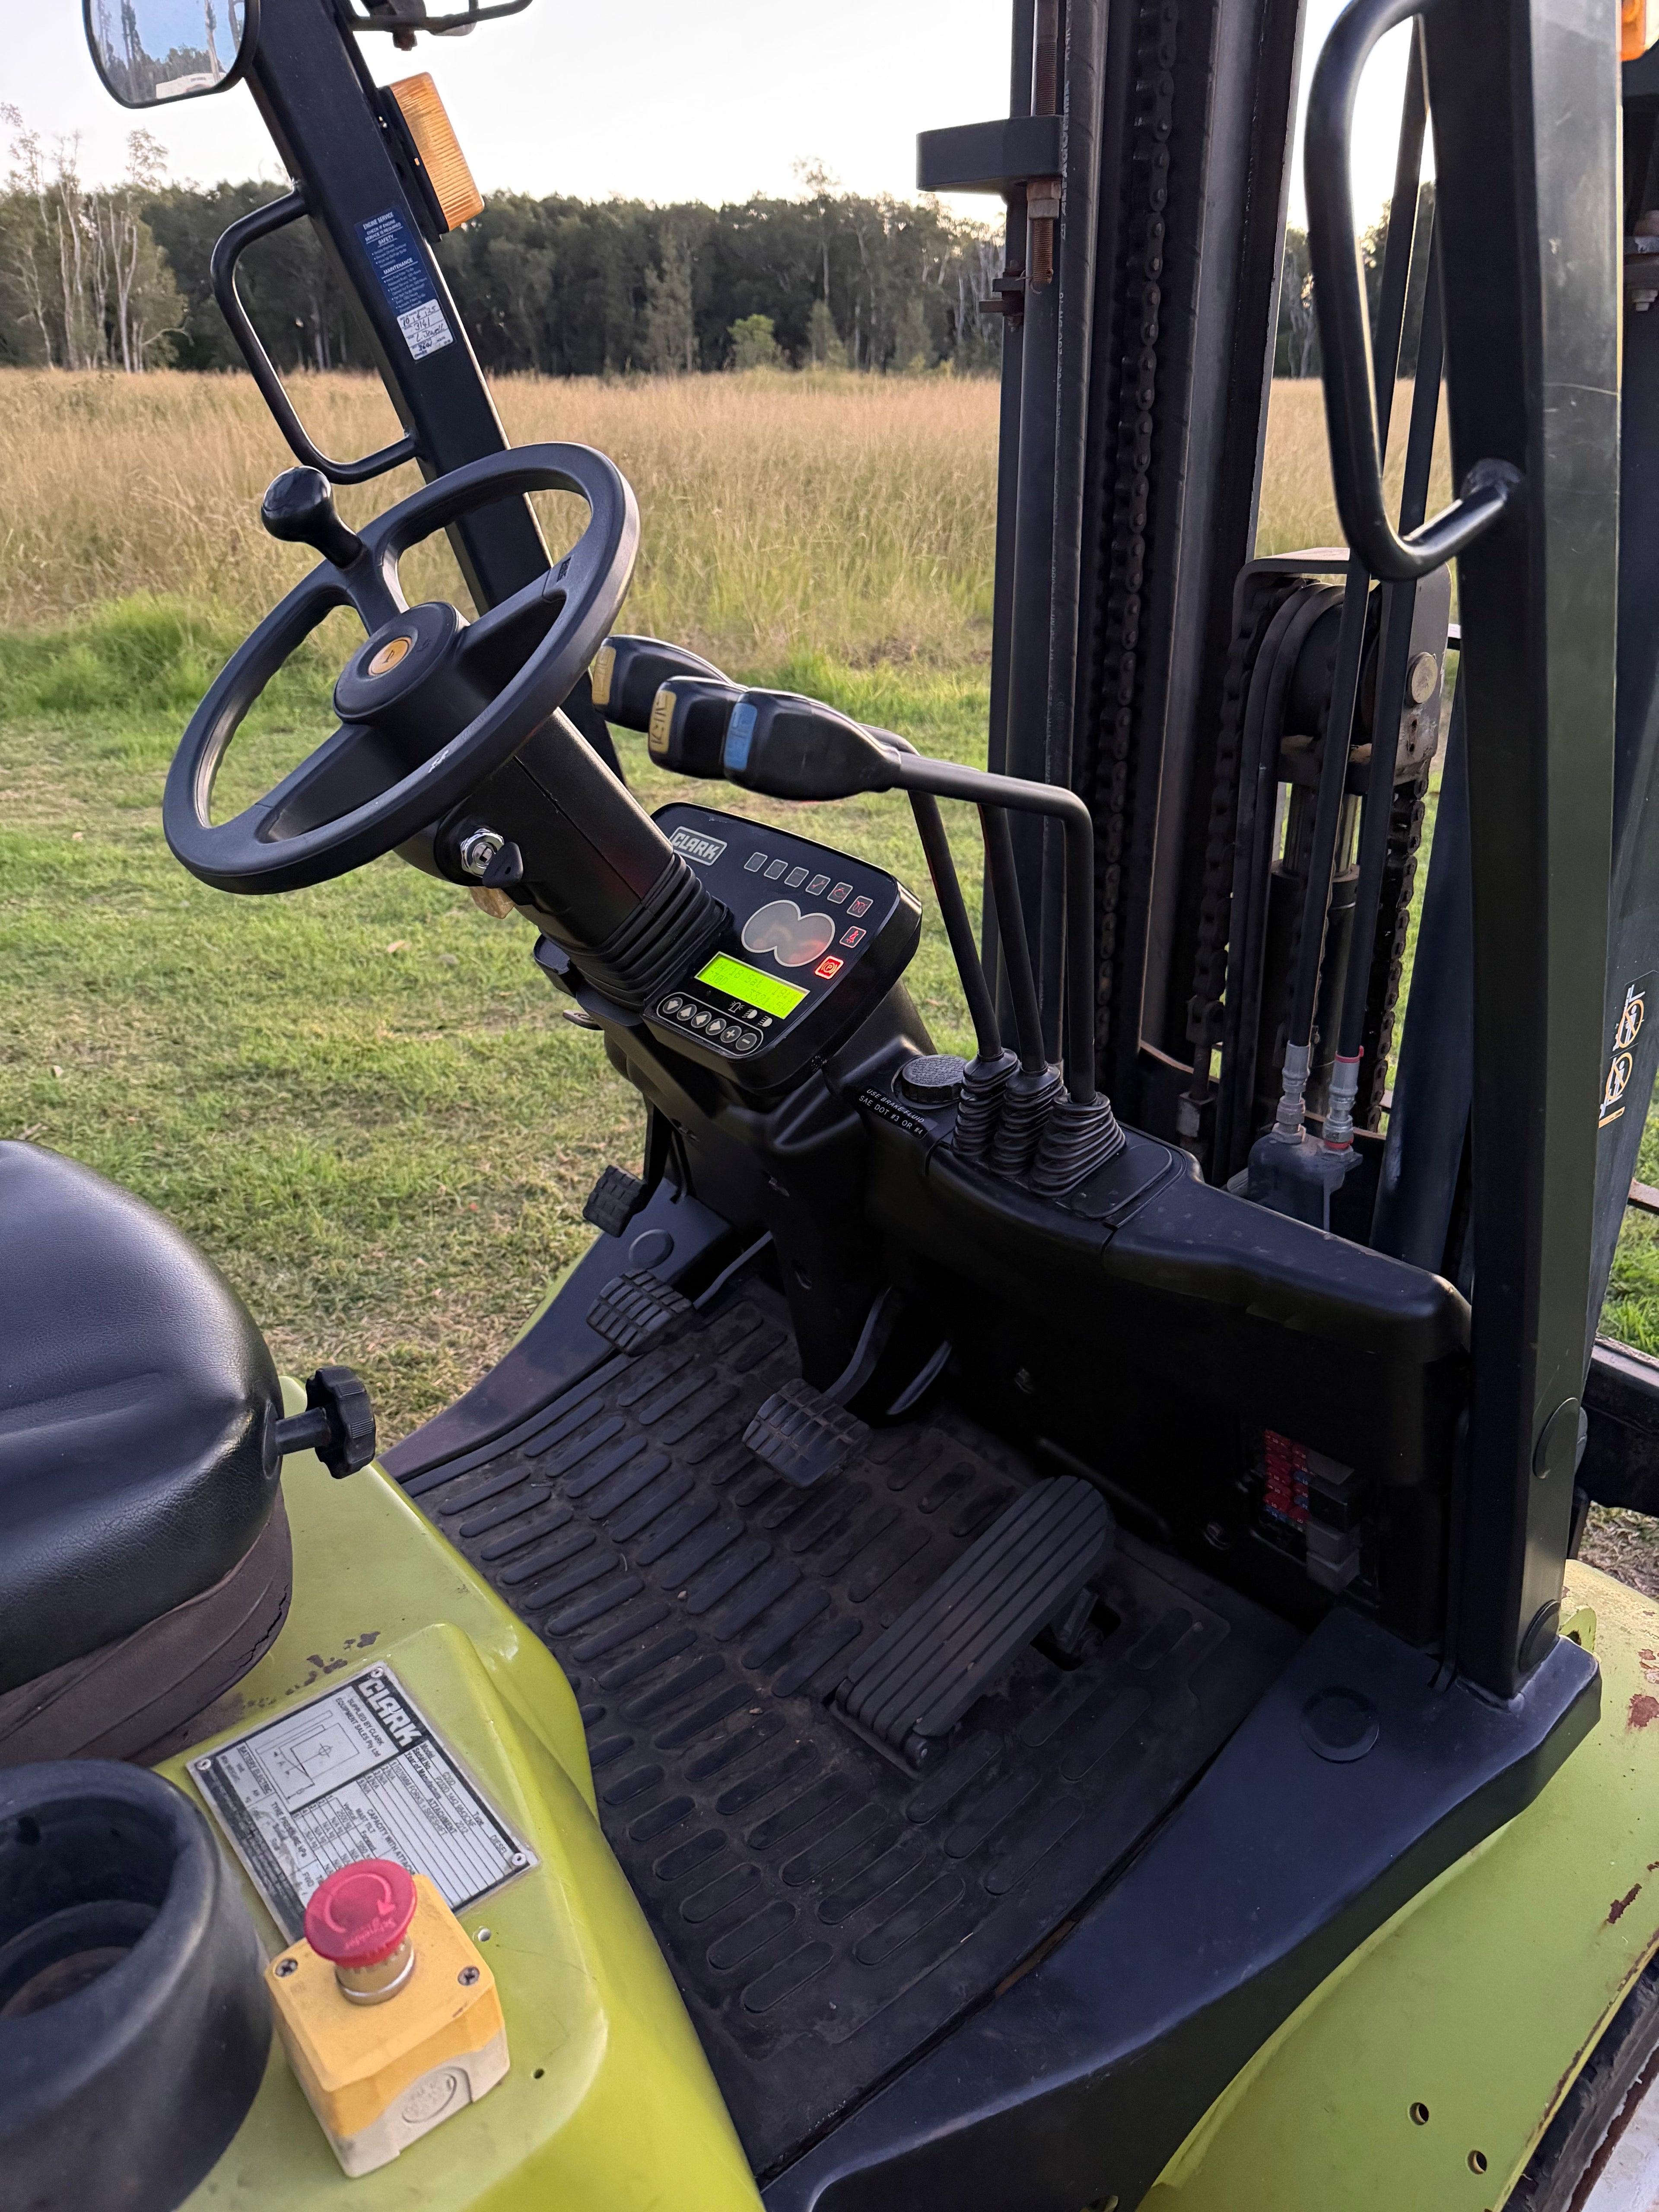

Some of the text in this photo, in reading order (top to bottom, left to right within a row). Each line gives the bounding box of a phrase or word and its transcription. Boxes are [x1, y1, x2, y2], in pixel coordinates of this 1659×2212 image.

[377, 211, 394, 223] SERVICE
[377, 234, 394, 245] SAFETY
[383, 257, 413, 274] MAINTENANCE
[671, 833, 720, 860] CLARK
[743, 973, 766, 988] Sat
[859, 1096, 873, 1106] SAE
[874, 1104, 890, 1115] DOT
[890, 1113, 899, 1122] #3
[902, 1120, 912, 1129] OR
[867, 1089, 925, 1123] USE BRAKE FLUID
[334, 1697, 381, 1758] EQUIPMENT SALES Pty Ltd
[346, 1698, 385, 1745] SUPPLIED BY CLARK
[356, 1675, 423, 1747] CLARK
[239, 1745, 257, 1769] BATTERY
[252, 1768, 273, 1794] ELECTRIC
[412, 1747, 427, 1762] Serial
[404, 1751, 416, 1764] Year
[416, 1768, 443, 1800] Manufacture
[455, 1820, 469, 1834] 2012
[420, 1742, 435, 1758] Model
[471, 1811, 486, 1826] Type
[489, 1834, 509, 1854] DIESEL
[270, 1802, 283, 1817] TYRE
[279, 1816, 303, 1847] PRESSURE
[313, 1826, 324, 1837] N/A
[321, 1821, 332, 1832] N/A
[342, 1802, 378, 1852] Vertical Forward
[355, 1808, 376, 1834] MAST TILT
[365, 1808, 389, 1836] CAPACITY
[384, 1835, 398, 1851] WITH
[422, 1807, 448, 1837] SIDESHIFT
[426, 1797, 458, 1835] ATTACHMENT
[330, 1816, 340, 1827] N/A
[350, 1848, 360, 1859] N/A
[301, 1871, 315, 1887] FWD
